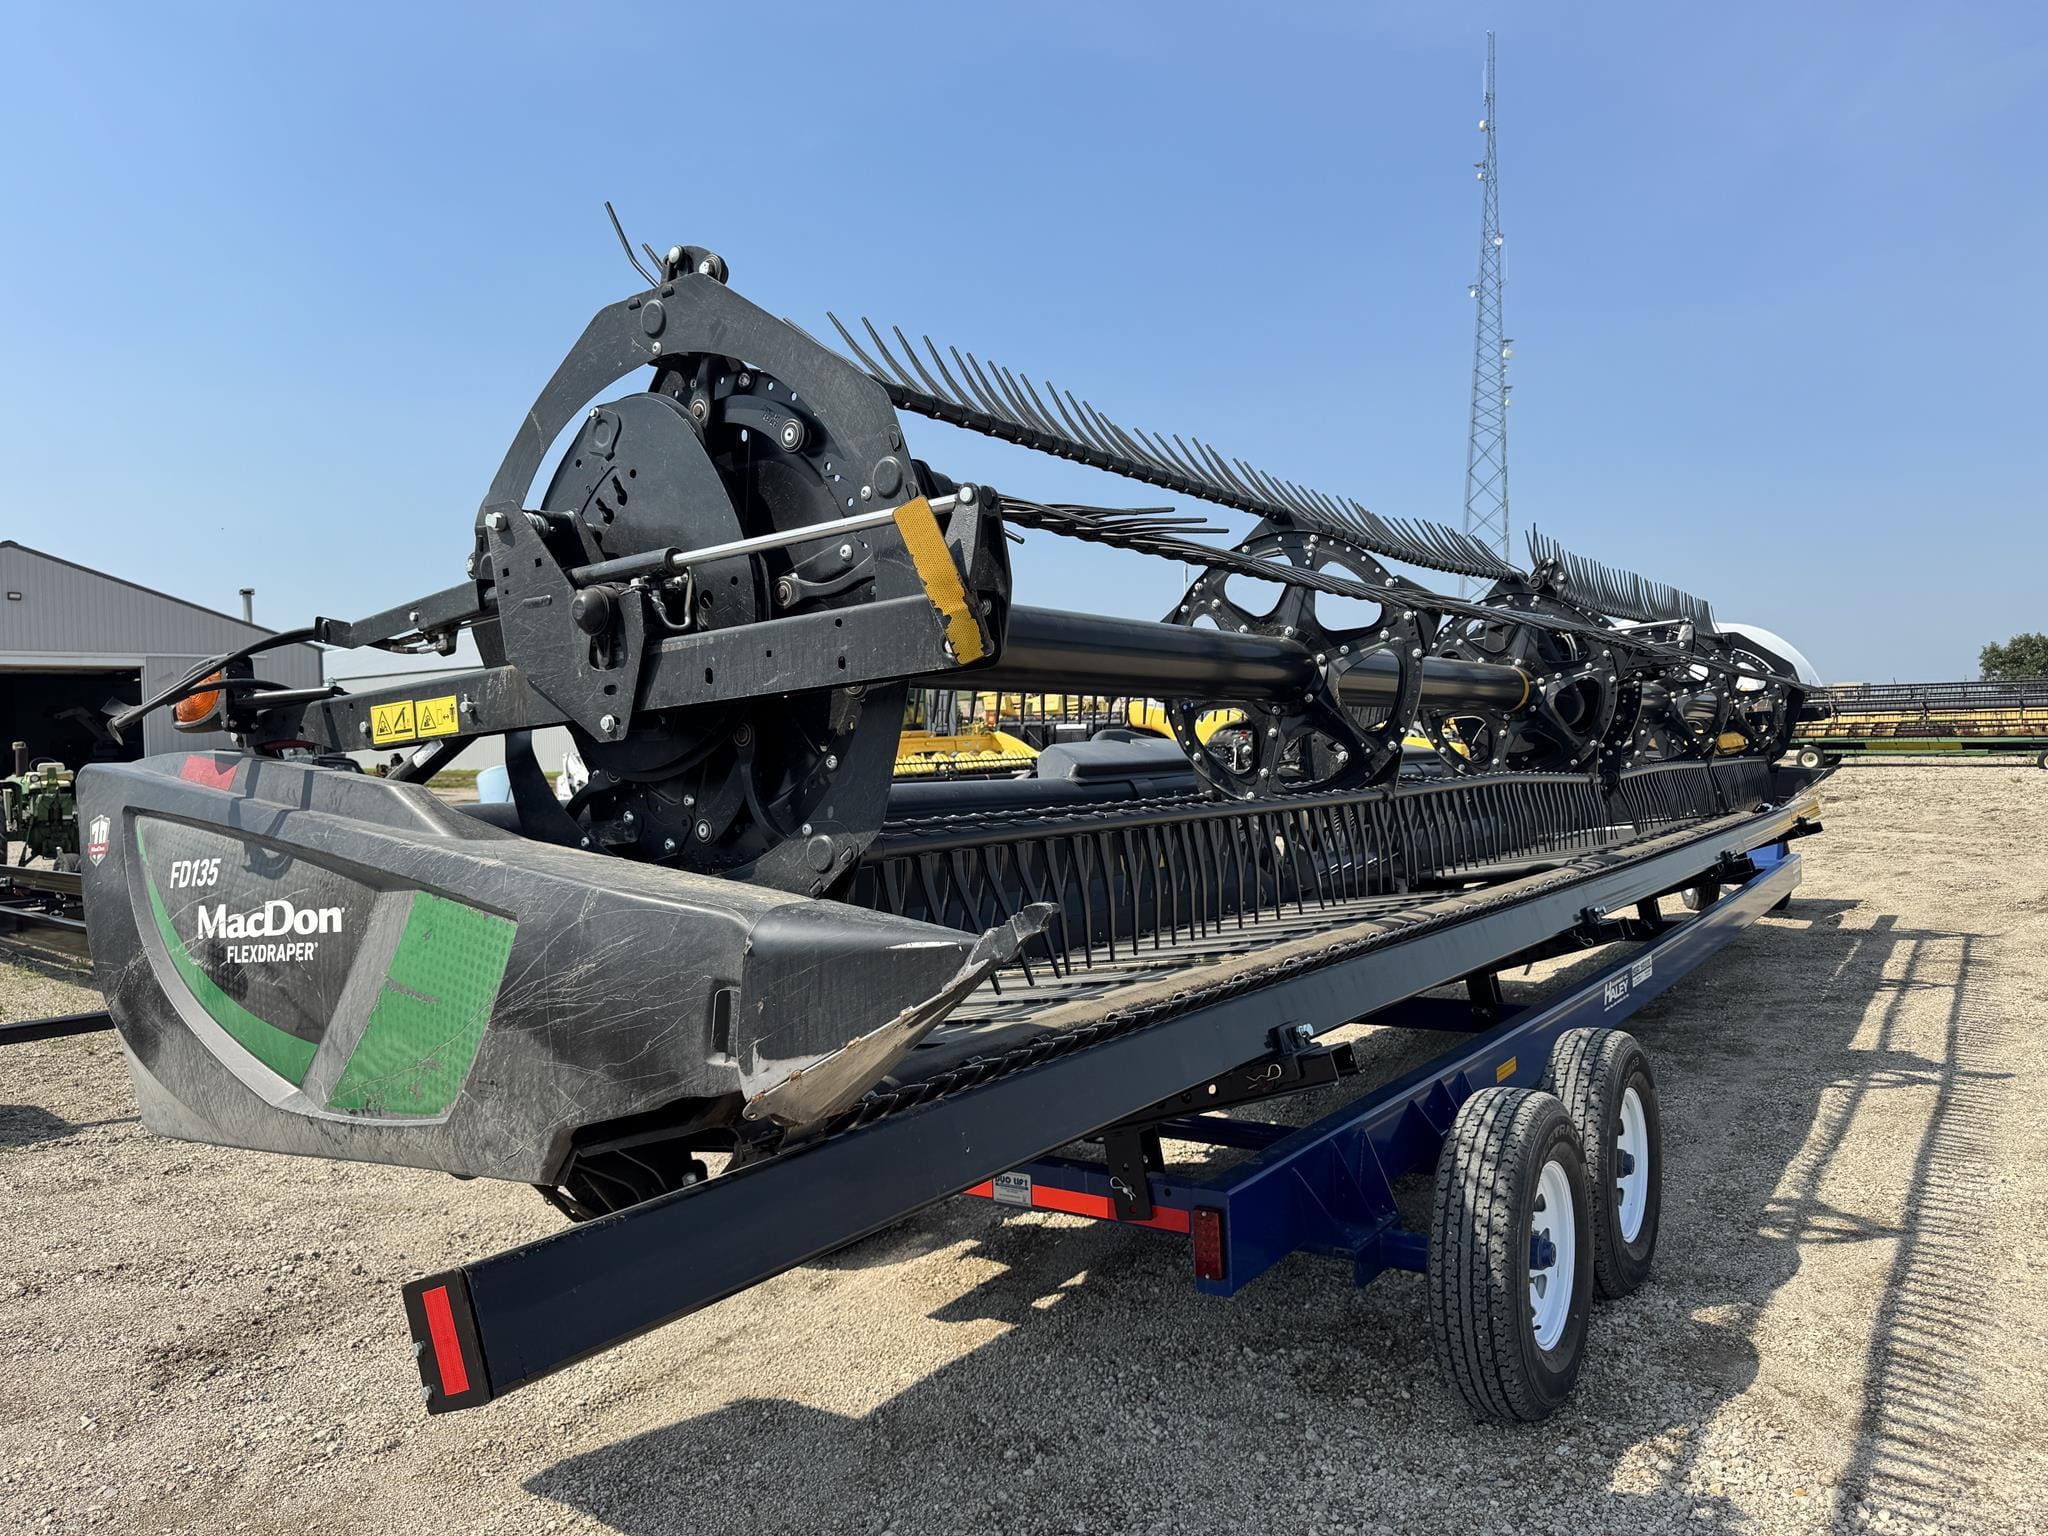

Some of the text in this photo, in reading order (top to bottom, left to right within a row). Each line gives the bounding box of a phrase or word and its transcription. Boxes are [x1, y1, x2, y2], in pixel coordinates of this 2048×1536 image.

[170, 858, 221, 888] FD135
[198, 900, 343, 939] MacDon
[227, 942, 315, 964] FLEXDRAPER
[1604, 979, 1629, 1006] HALEY
